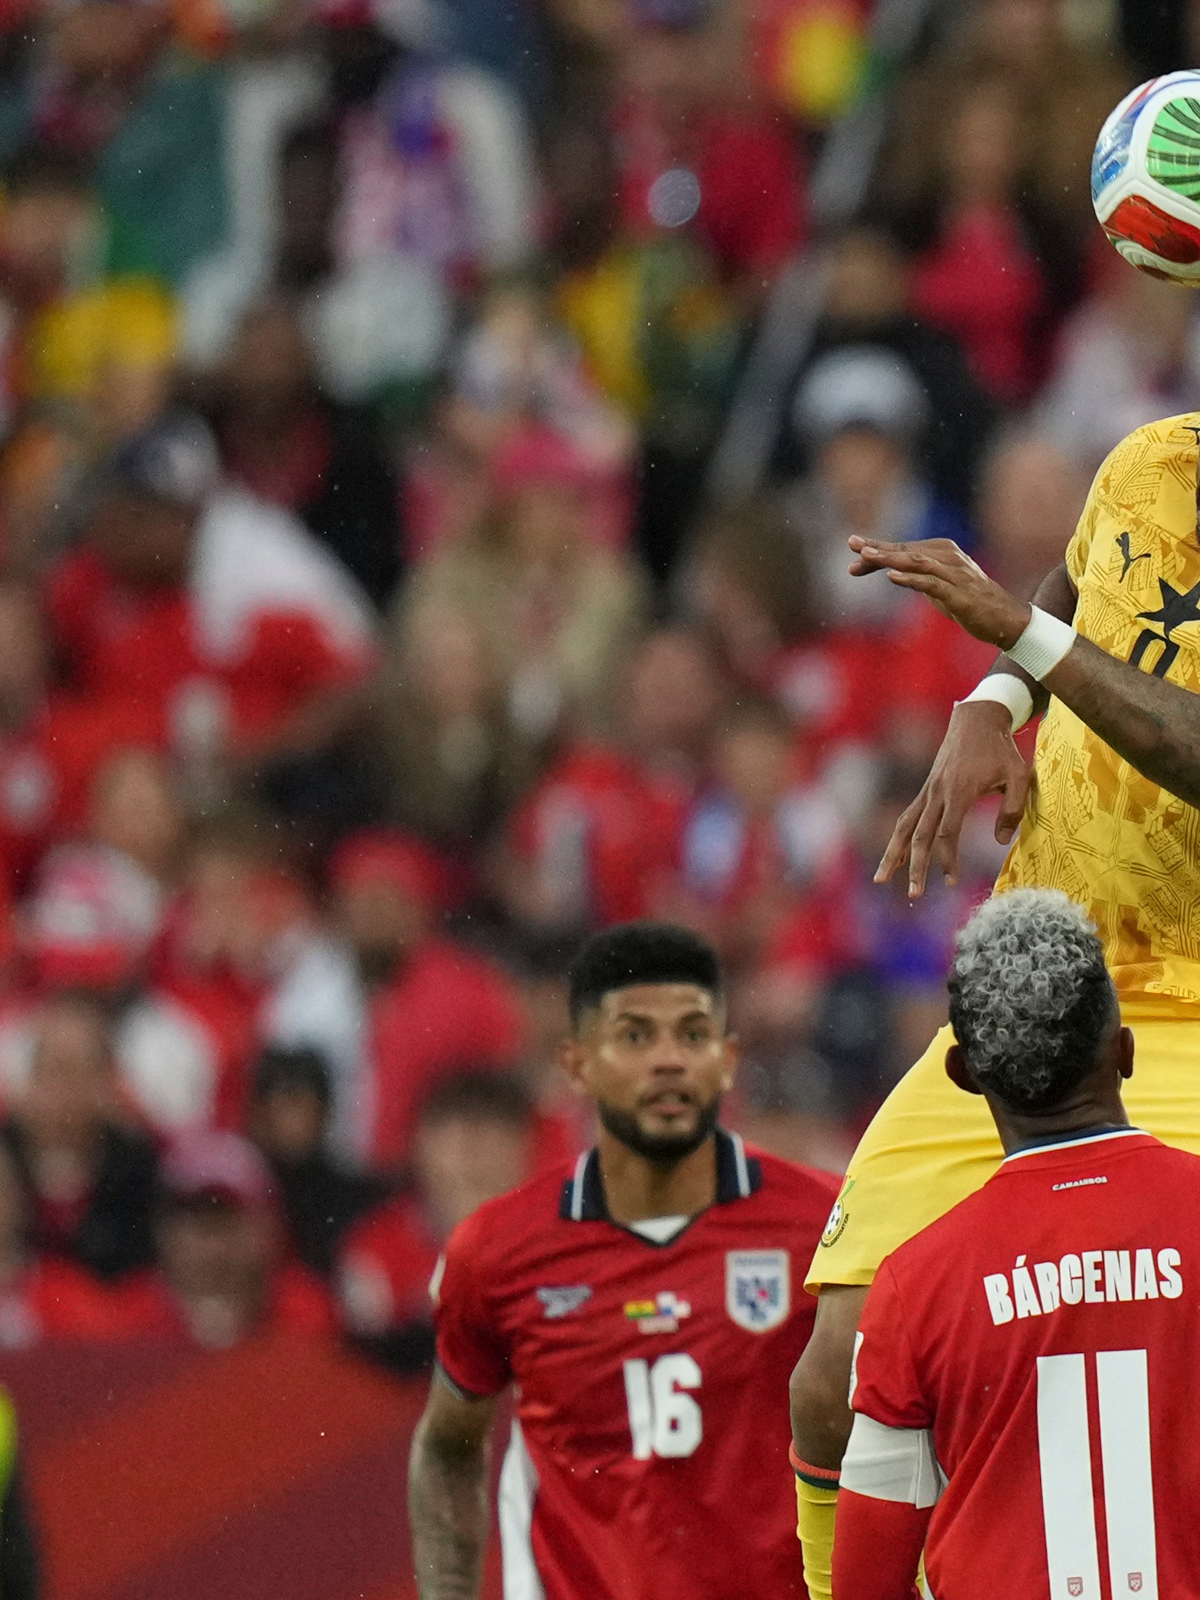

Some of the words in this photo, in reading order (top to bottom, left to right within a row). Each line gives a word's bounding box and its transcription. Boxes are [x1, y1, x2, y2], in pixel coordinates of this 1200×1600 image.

[983, 1247, 1184, 1326] BÁRCENAS
[623, 1351, 703, 1461] 16
[1036, 1348, 1159, 1600] 11
